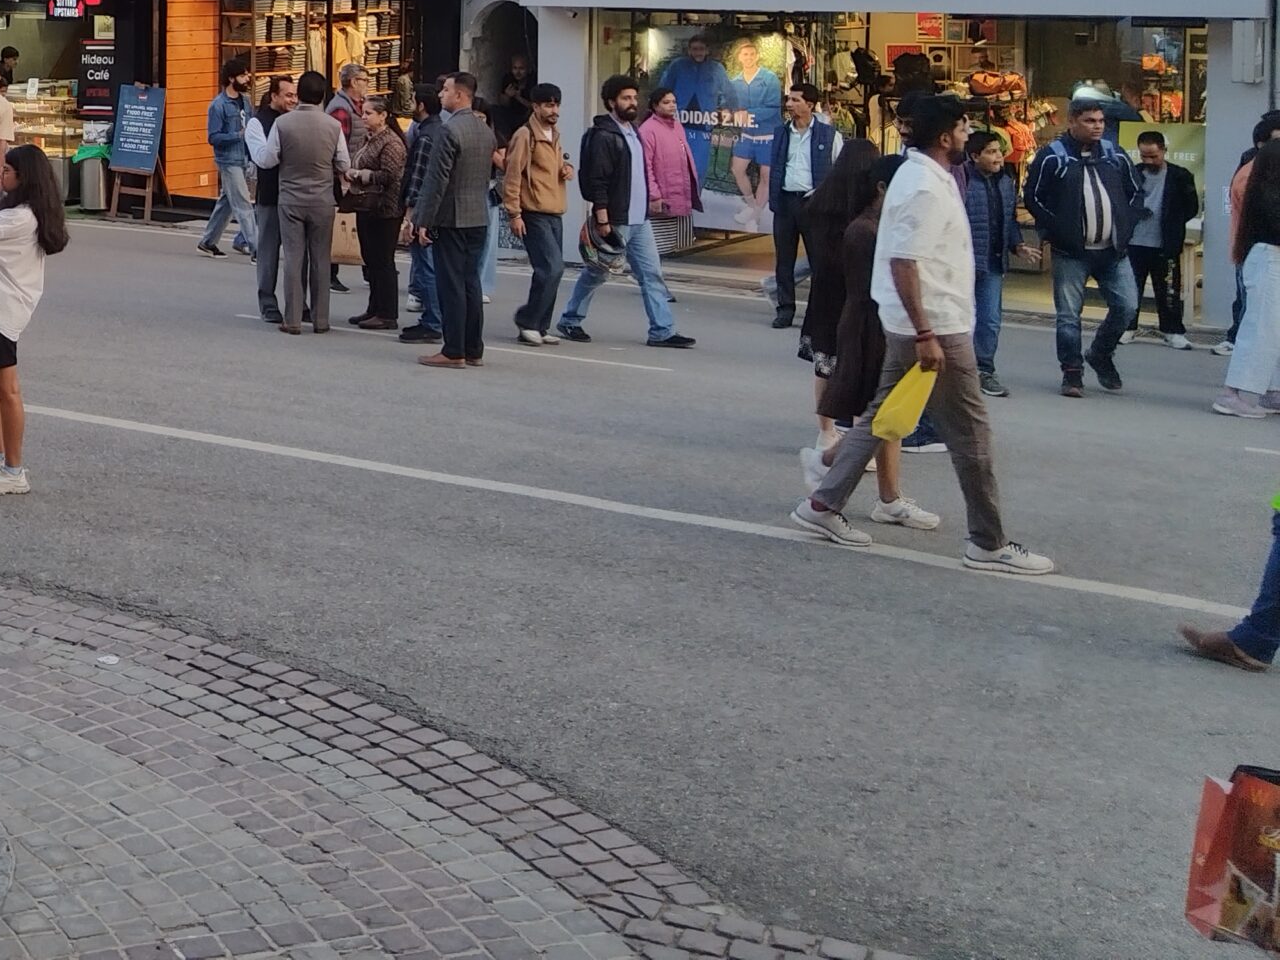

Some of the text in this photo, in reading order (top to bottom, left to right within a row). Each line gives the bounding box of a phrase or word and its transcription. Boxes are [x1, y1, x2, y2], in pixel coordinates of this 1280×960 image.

[53, 7, 79, 18] UPSTAIRS
[87, 69, 110, 81] Café
[673, 110, 719, 125] ADIDAS
[1173, 152, 1196, 162] FREE
